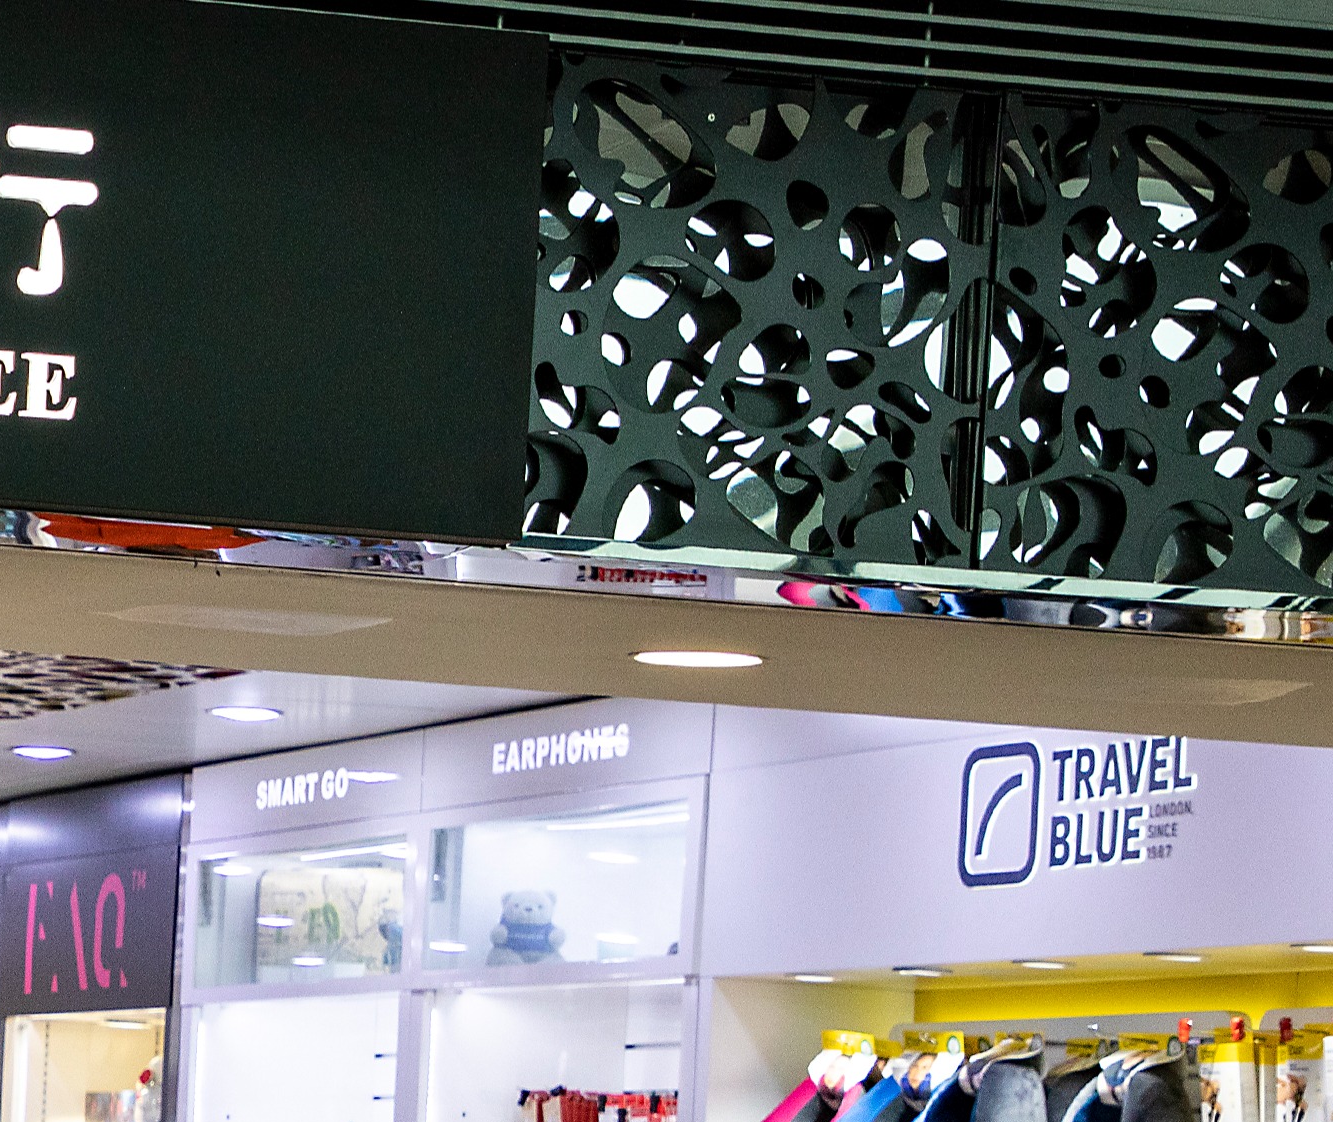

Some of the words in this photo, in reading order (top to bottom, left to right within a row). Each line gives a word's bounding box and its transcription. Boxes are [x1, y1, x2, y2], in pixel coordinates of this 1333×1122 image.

[492, 723, 630, 775] EARPHONES
[1052, 737, 1196, 803] TRAVEL
[256, 770, 319, 810] SMART
[321, 767, 349, 799] GO
[1049, 805, 1147, 869] BLUE
[1148, 822, 1178, 839] SINCE
[1148, 844, 1173, 859] 1987
